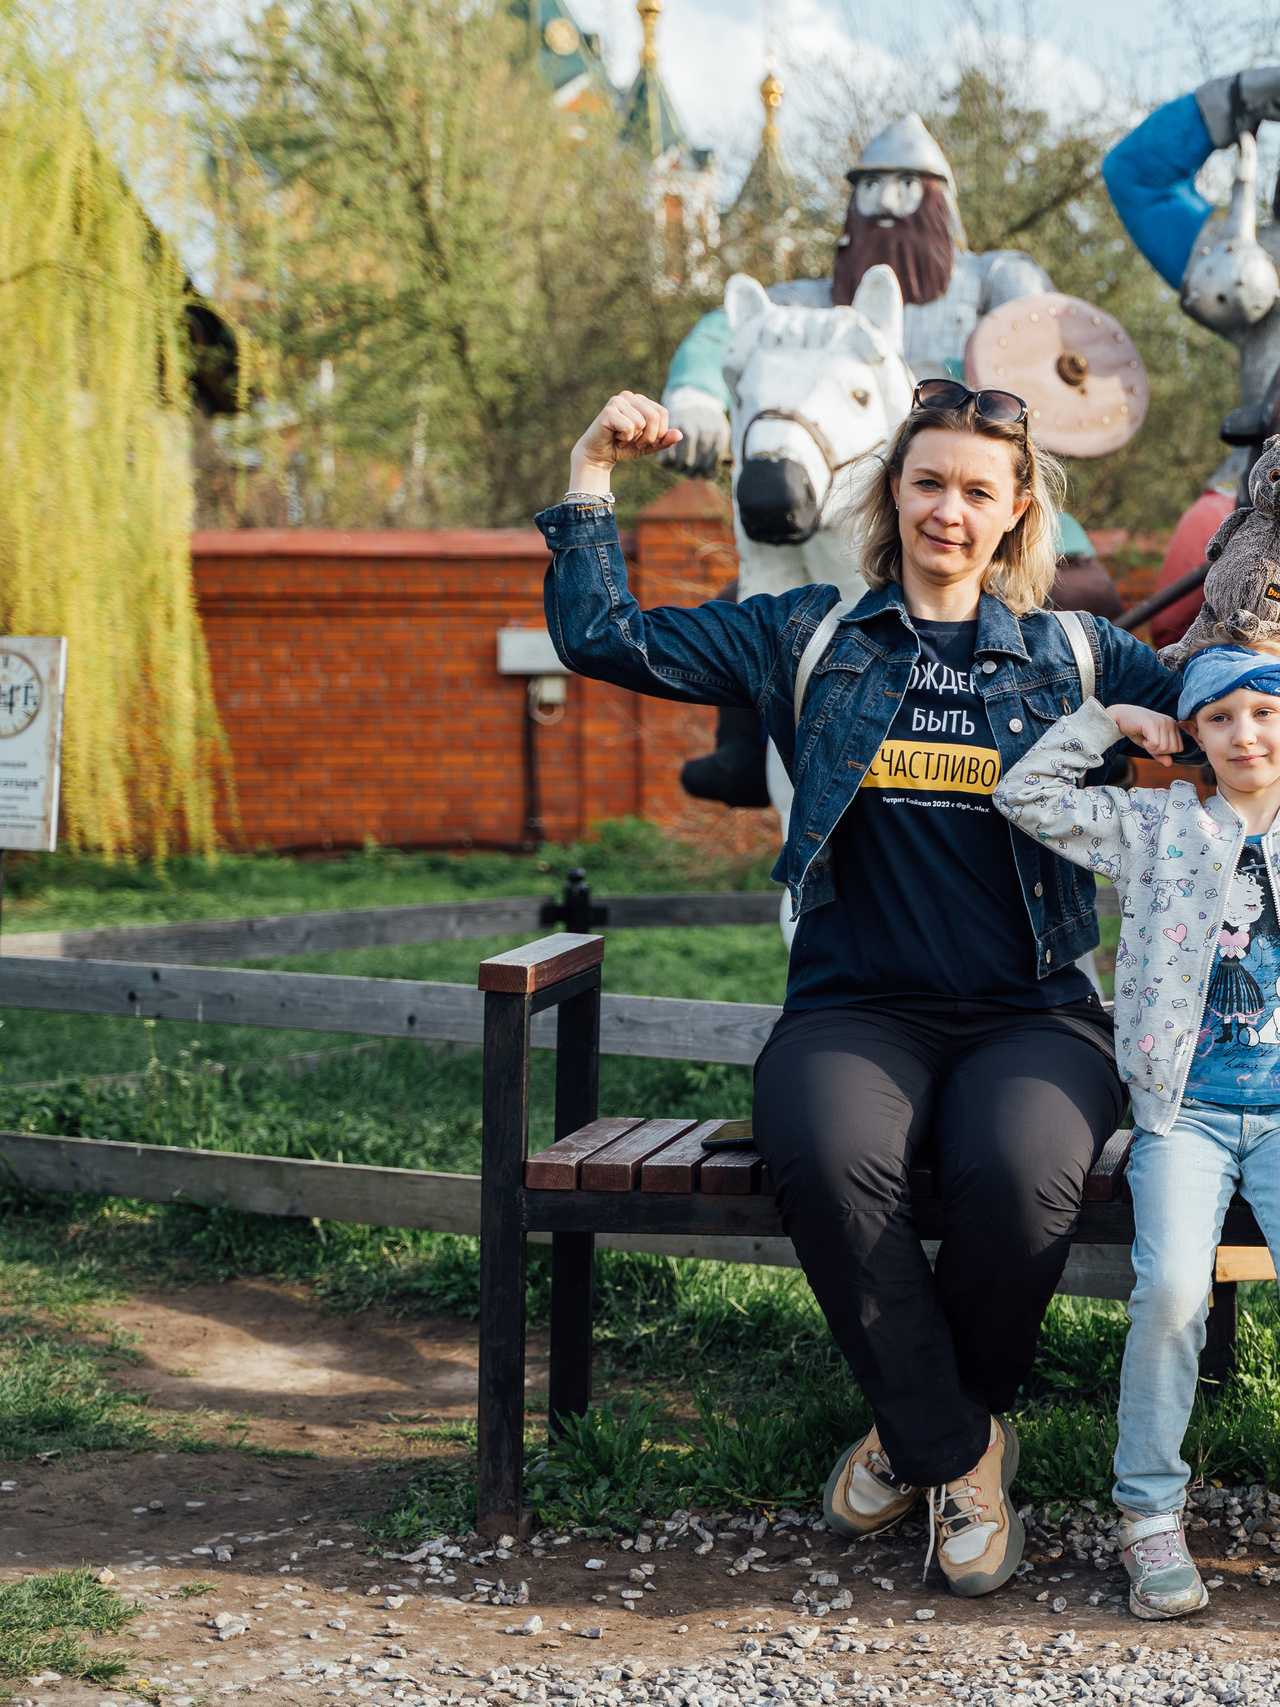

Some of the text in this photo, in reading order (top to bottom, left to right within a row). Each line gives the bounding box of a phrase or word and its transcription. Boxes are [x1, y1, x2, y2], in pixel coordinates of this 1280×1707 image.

[912, 708, 976, 736] БЫТЬ
[869, 748, 1000, 787] ЧАСТЛИВО
[956, 803, 990, 813] @gk_alex
